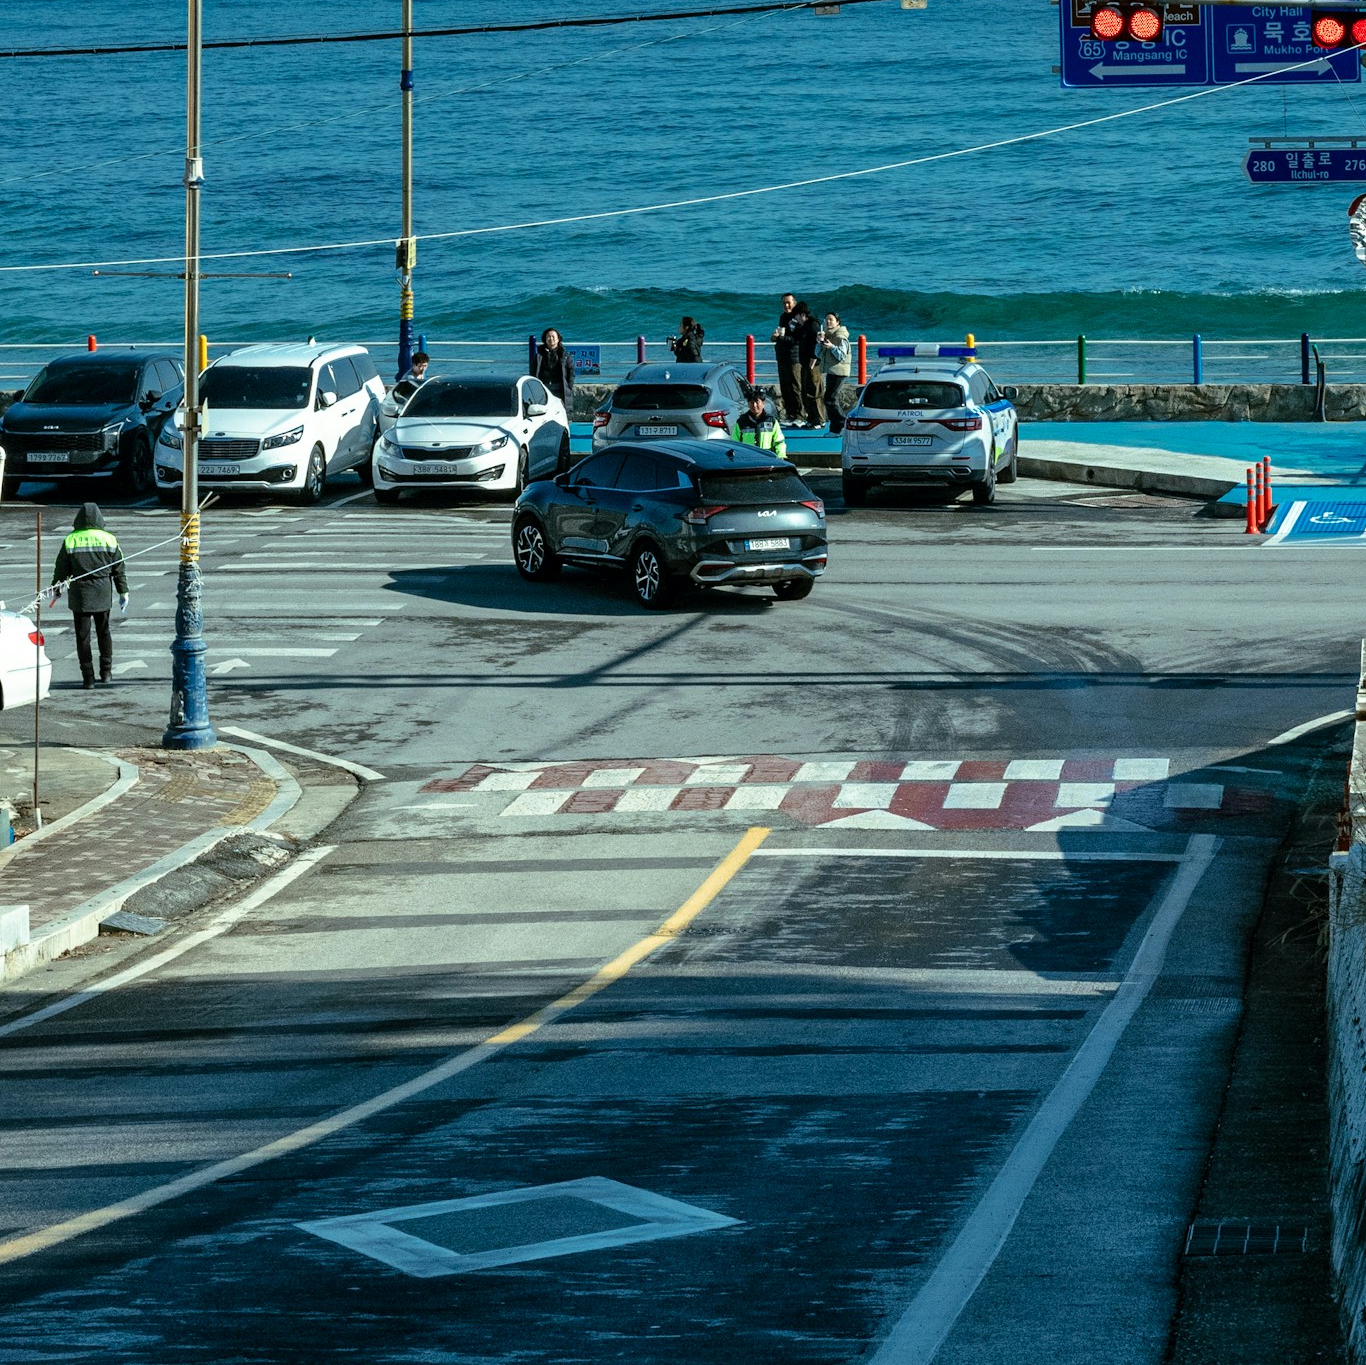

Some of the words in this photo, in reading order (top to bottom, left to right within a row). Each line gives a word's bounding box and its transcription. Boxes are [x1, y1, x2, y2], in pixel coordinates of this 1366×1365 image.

[1164, 11, 1194, 22] each
[1252, 7, 1276, 19] City
[1280, 6, 1303, 17] Hall
[1083, 42, 1101, 56] 65
[1113, 51, 1172, 62] Mangsang
[1175, 49, 1188, 60] IC
[1264, 45, 1302, 55] Mukho
[1253, 161, 1275, 172] 280
[1286, 152, 1332, 169] 일출로
[1345, 159, 1366, 171] 276
[1291, 170, 1329, 179] Ilchul-ro
